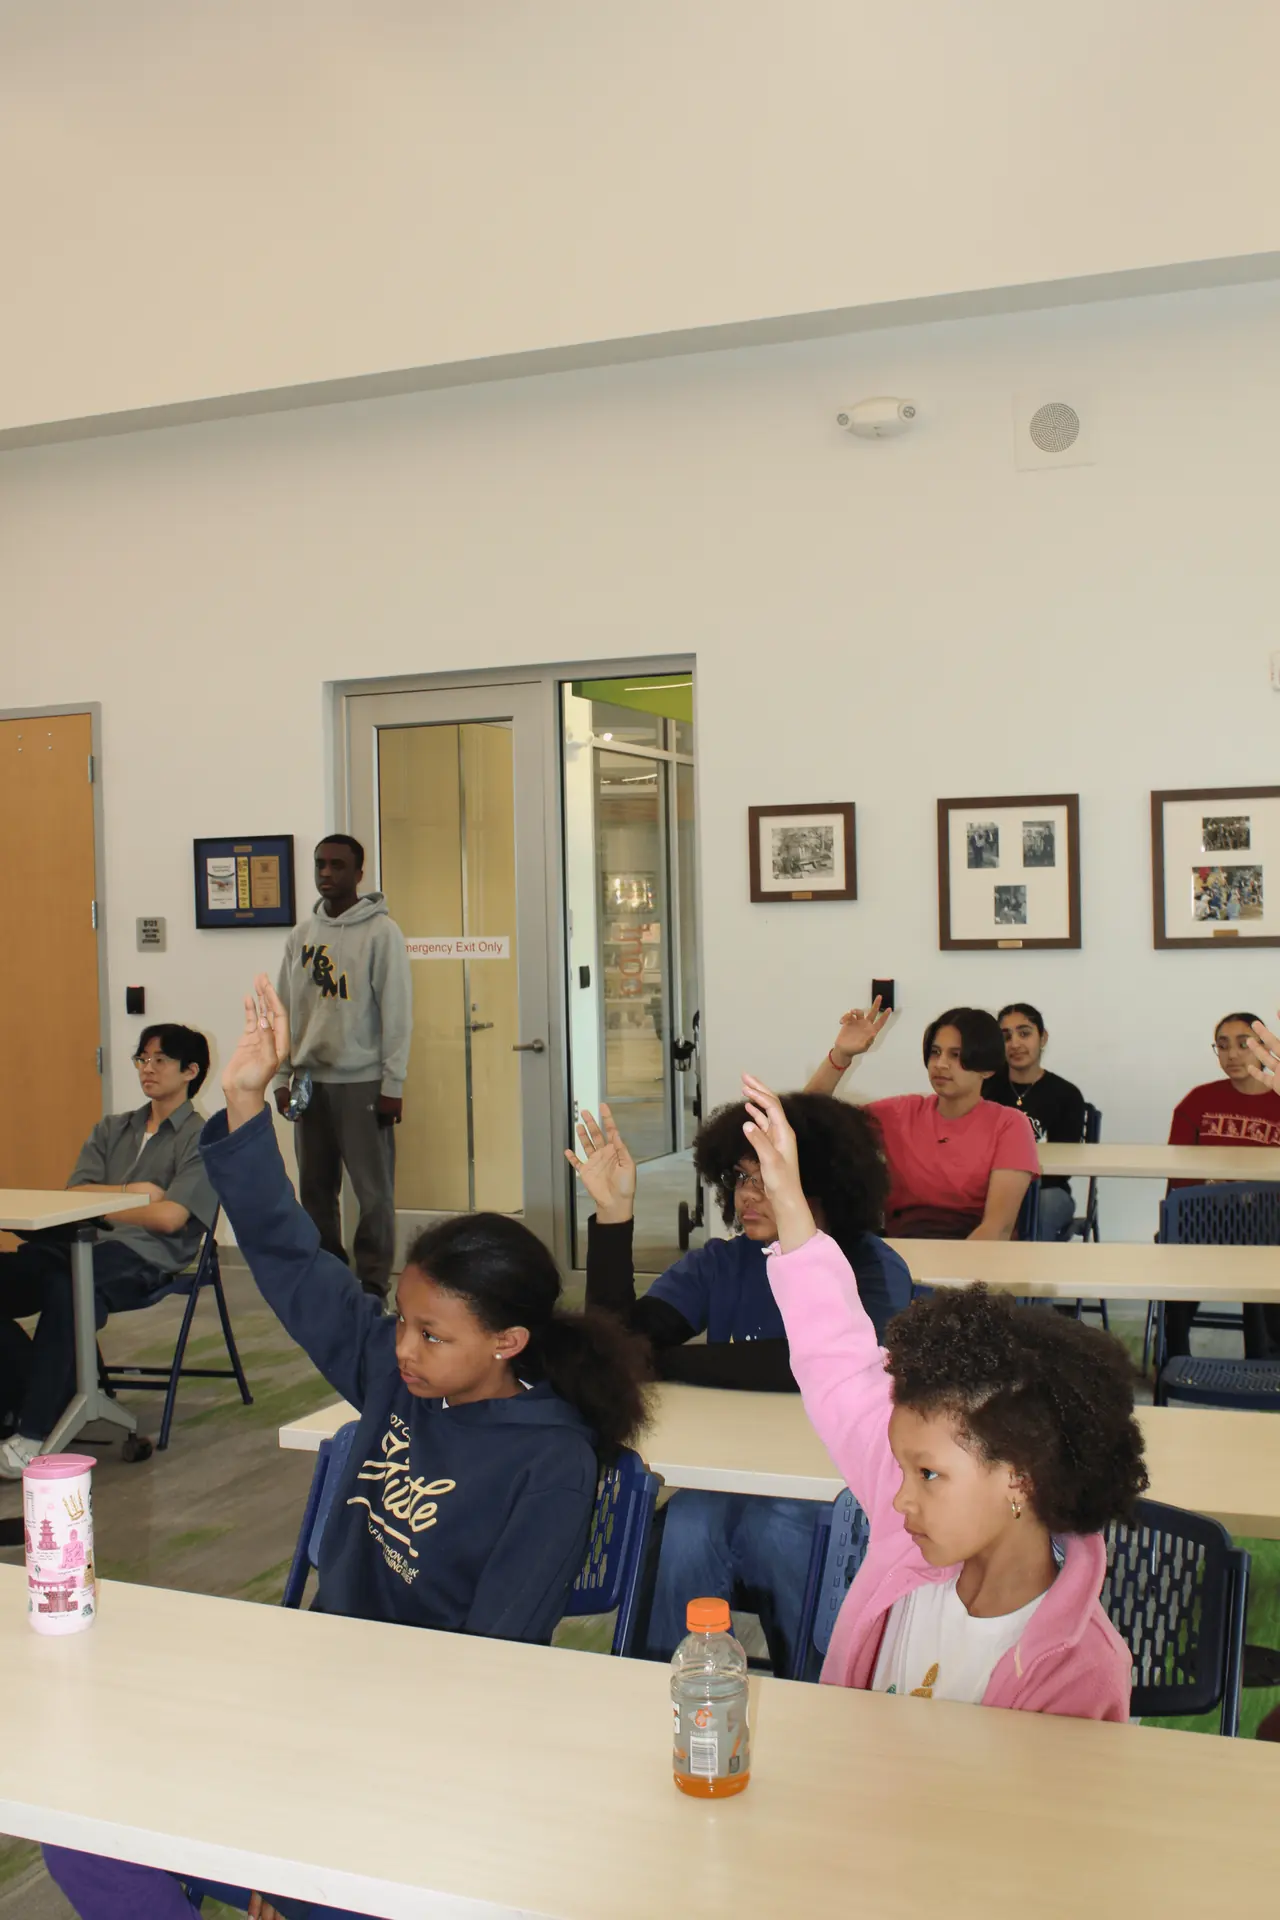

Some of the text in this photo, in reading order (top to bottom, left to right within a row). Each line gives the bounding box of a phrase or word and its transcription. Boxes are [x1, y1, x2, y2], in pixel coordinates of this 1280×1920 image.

[405, 941, 503, 955] mergency Exit Only
[389, 1412, 405, 1428] OT
